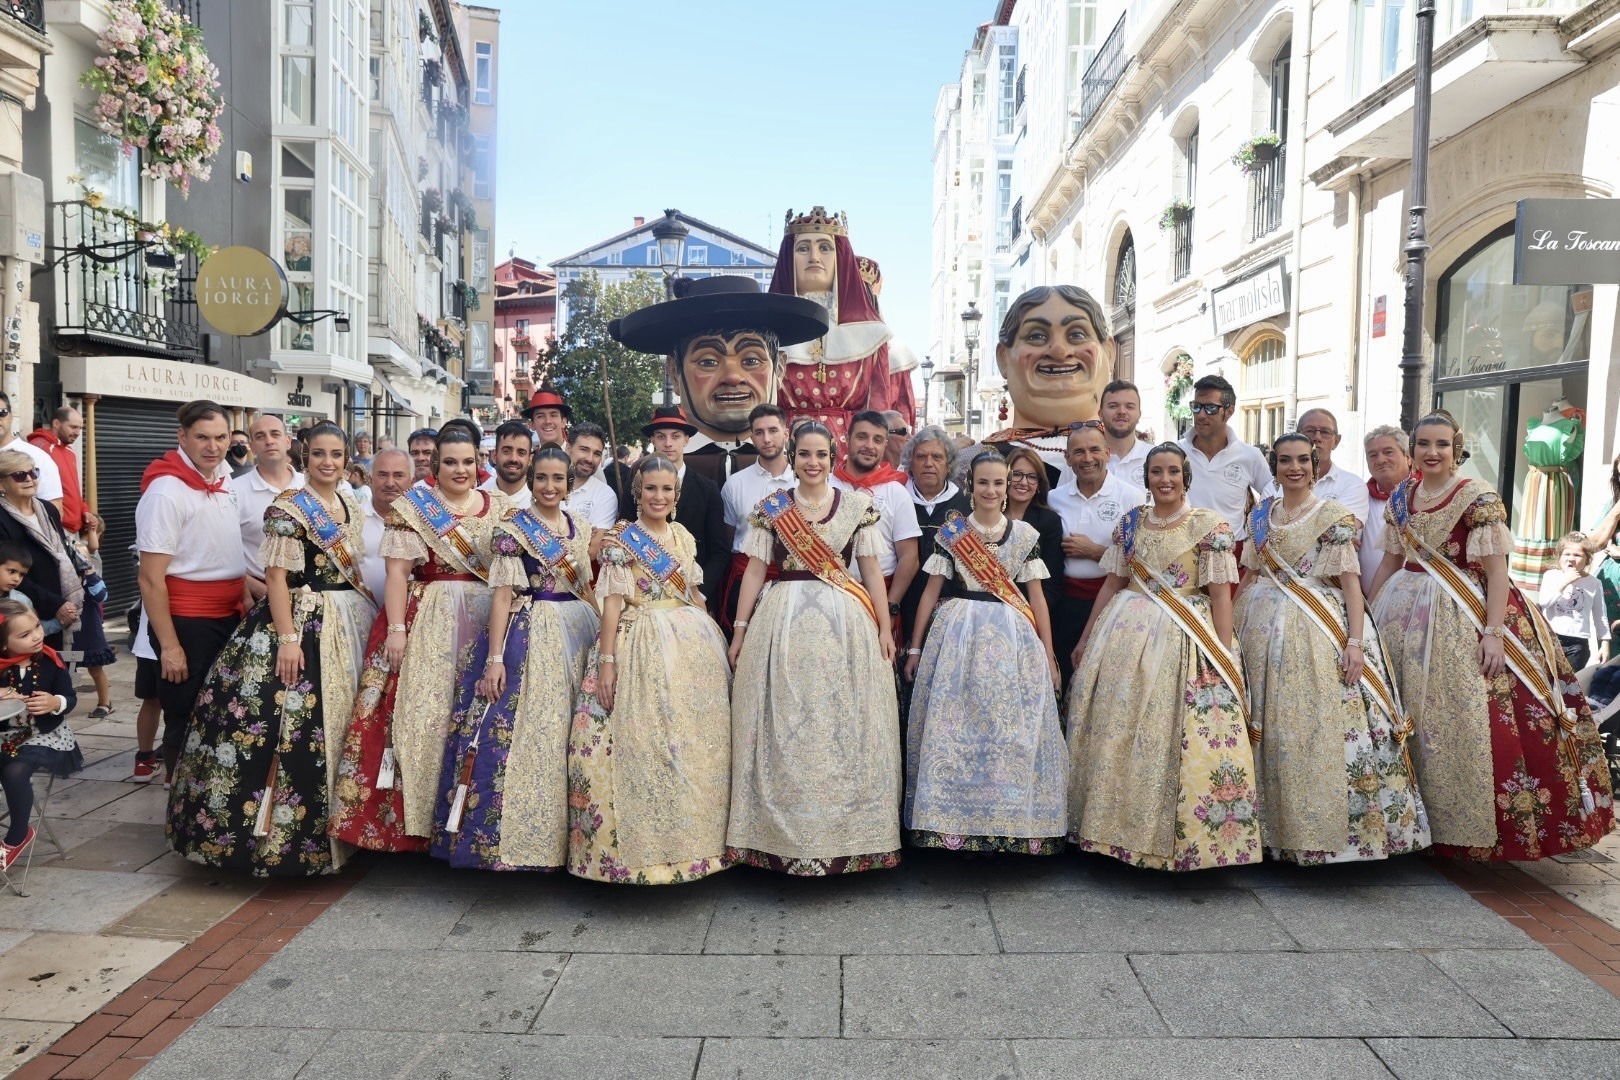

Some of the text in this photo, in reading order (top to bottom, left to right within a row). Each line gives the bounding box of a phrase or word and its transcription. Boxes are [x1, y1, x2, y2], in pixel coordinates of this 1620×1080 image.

[1527, 229, 1620, 251] La Toscan
[204, 276, 273, 290] LAURA
[204, 291, 273, 305] JORGE
[1218, 271, 1281, 325] marmolista
[1447, 355, 1507, 377] La Toscana
[127, 363, 240, 392] LAURA JORGE
[120, 384, 243, 403] JOYAS DE AUTOR WORKSHOP
